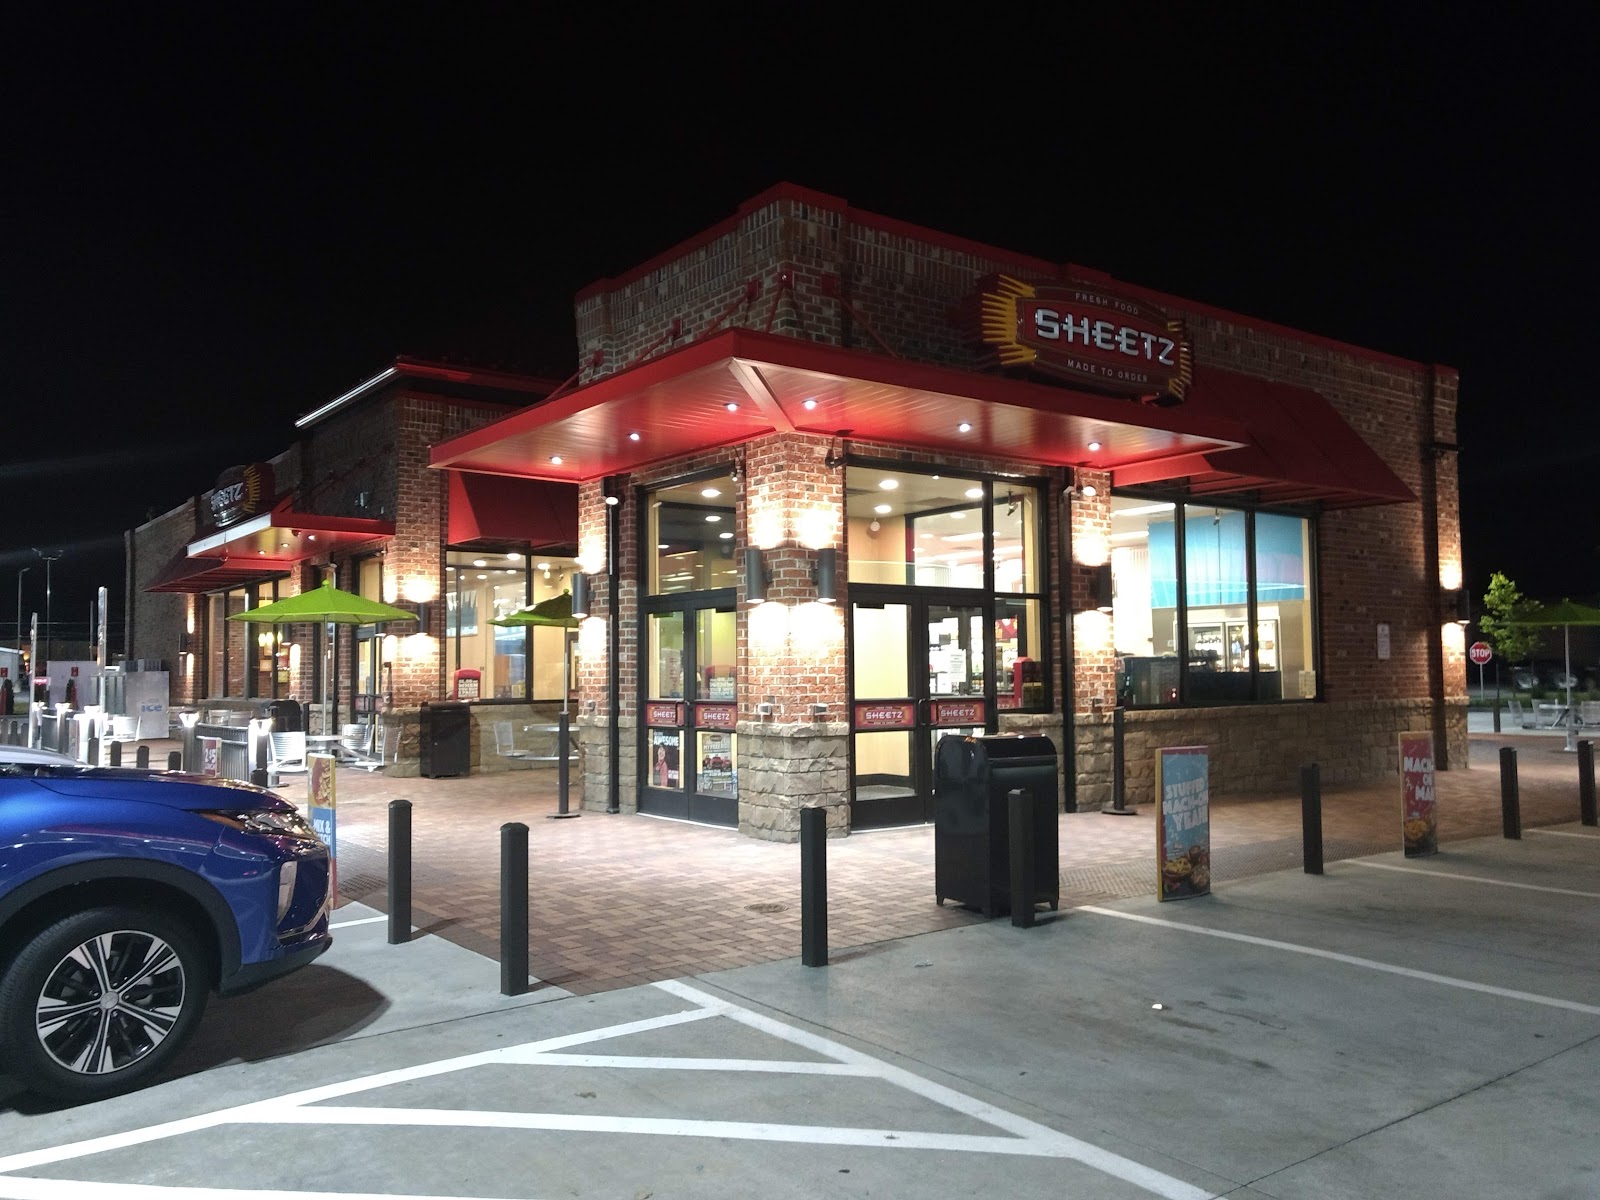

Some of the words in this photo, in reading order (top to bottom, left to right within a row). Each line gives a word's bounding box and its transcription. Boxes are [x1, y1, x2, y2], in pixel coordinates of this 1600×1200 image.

[1075, 292, 1108, 306] FRESH
[1115, 301, 1139, 315] FOOD
[1035, 308, 1175, 366] SHEETZ
[1067, 359, 1096, 373] MADE
[1101, 367, 1113, 377] TO
[1118, 371, 1148, 383] ORDER
[1471, 648, 1490, 658] STOP
[653, 710, 677, 719] SHEETZ
[703, 712, 730, 720] SHEETZ
[865, 711, 903, 719] SHEETZ
[941, 709, 975, 717] SHEETZ
[653, 736, 679, 747] AWESOME
[313, 818, 325, 834] MIX
